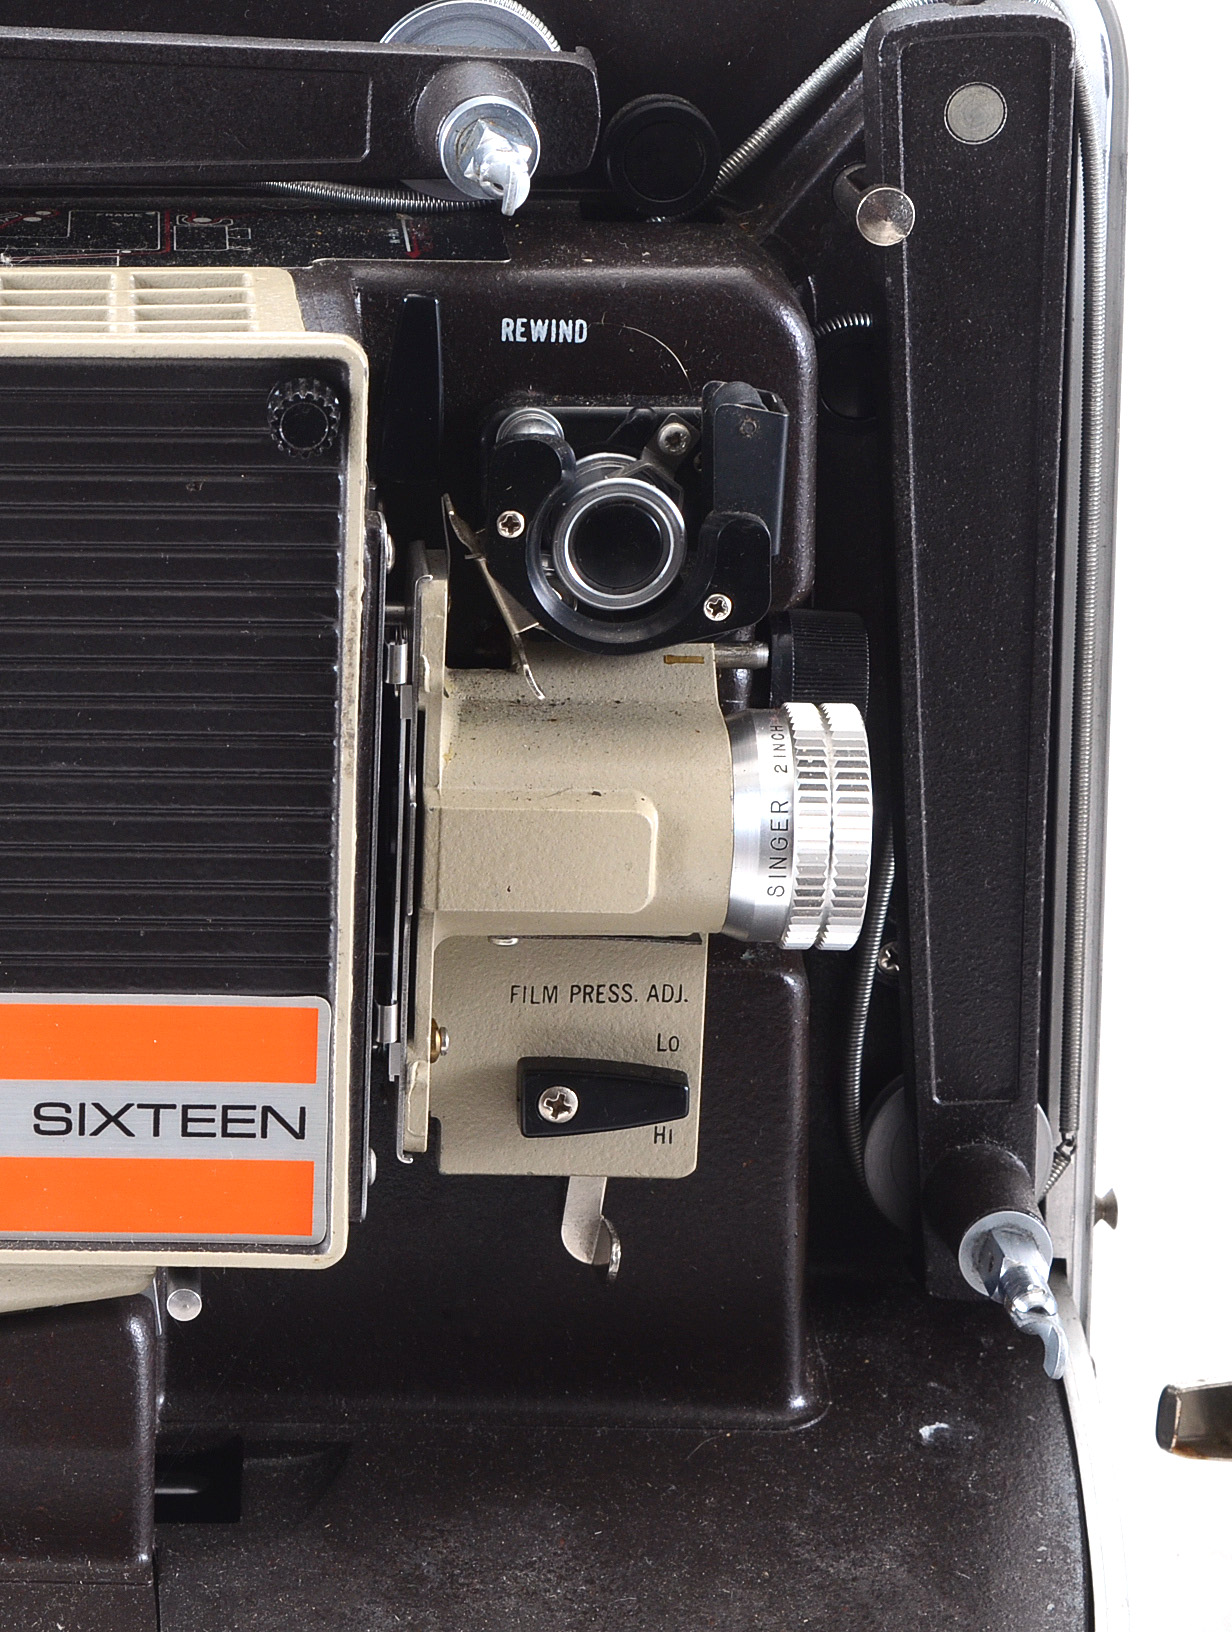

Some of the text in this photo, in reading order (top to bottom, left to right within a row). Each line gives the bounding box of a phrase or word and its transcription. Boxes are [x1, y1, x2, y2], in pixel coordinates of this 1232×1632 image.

[501, 317, 588, 344] REWIND
[766, 723, 789, 898] SINGER 2 INCH
[509, 983, 689, 1005] FILM PRESS. ADJ.
[32, 1101, 307, 1141] SIXTEEN
